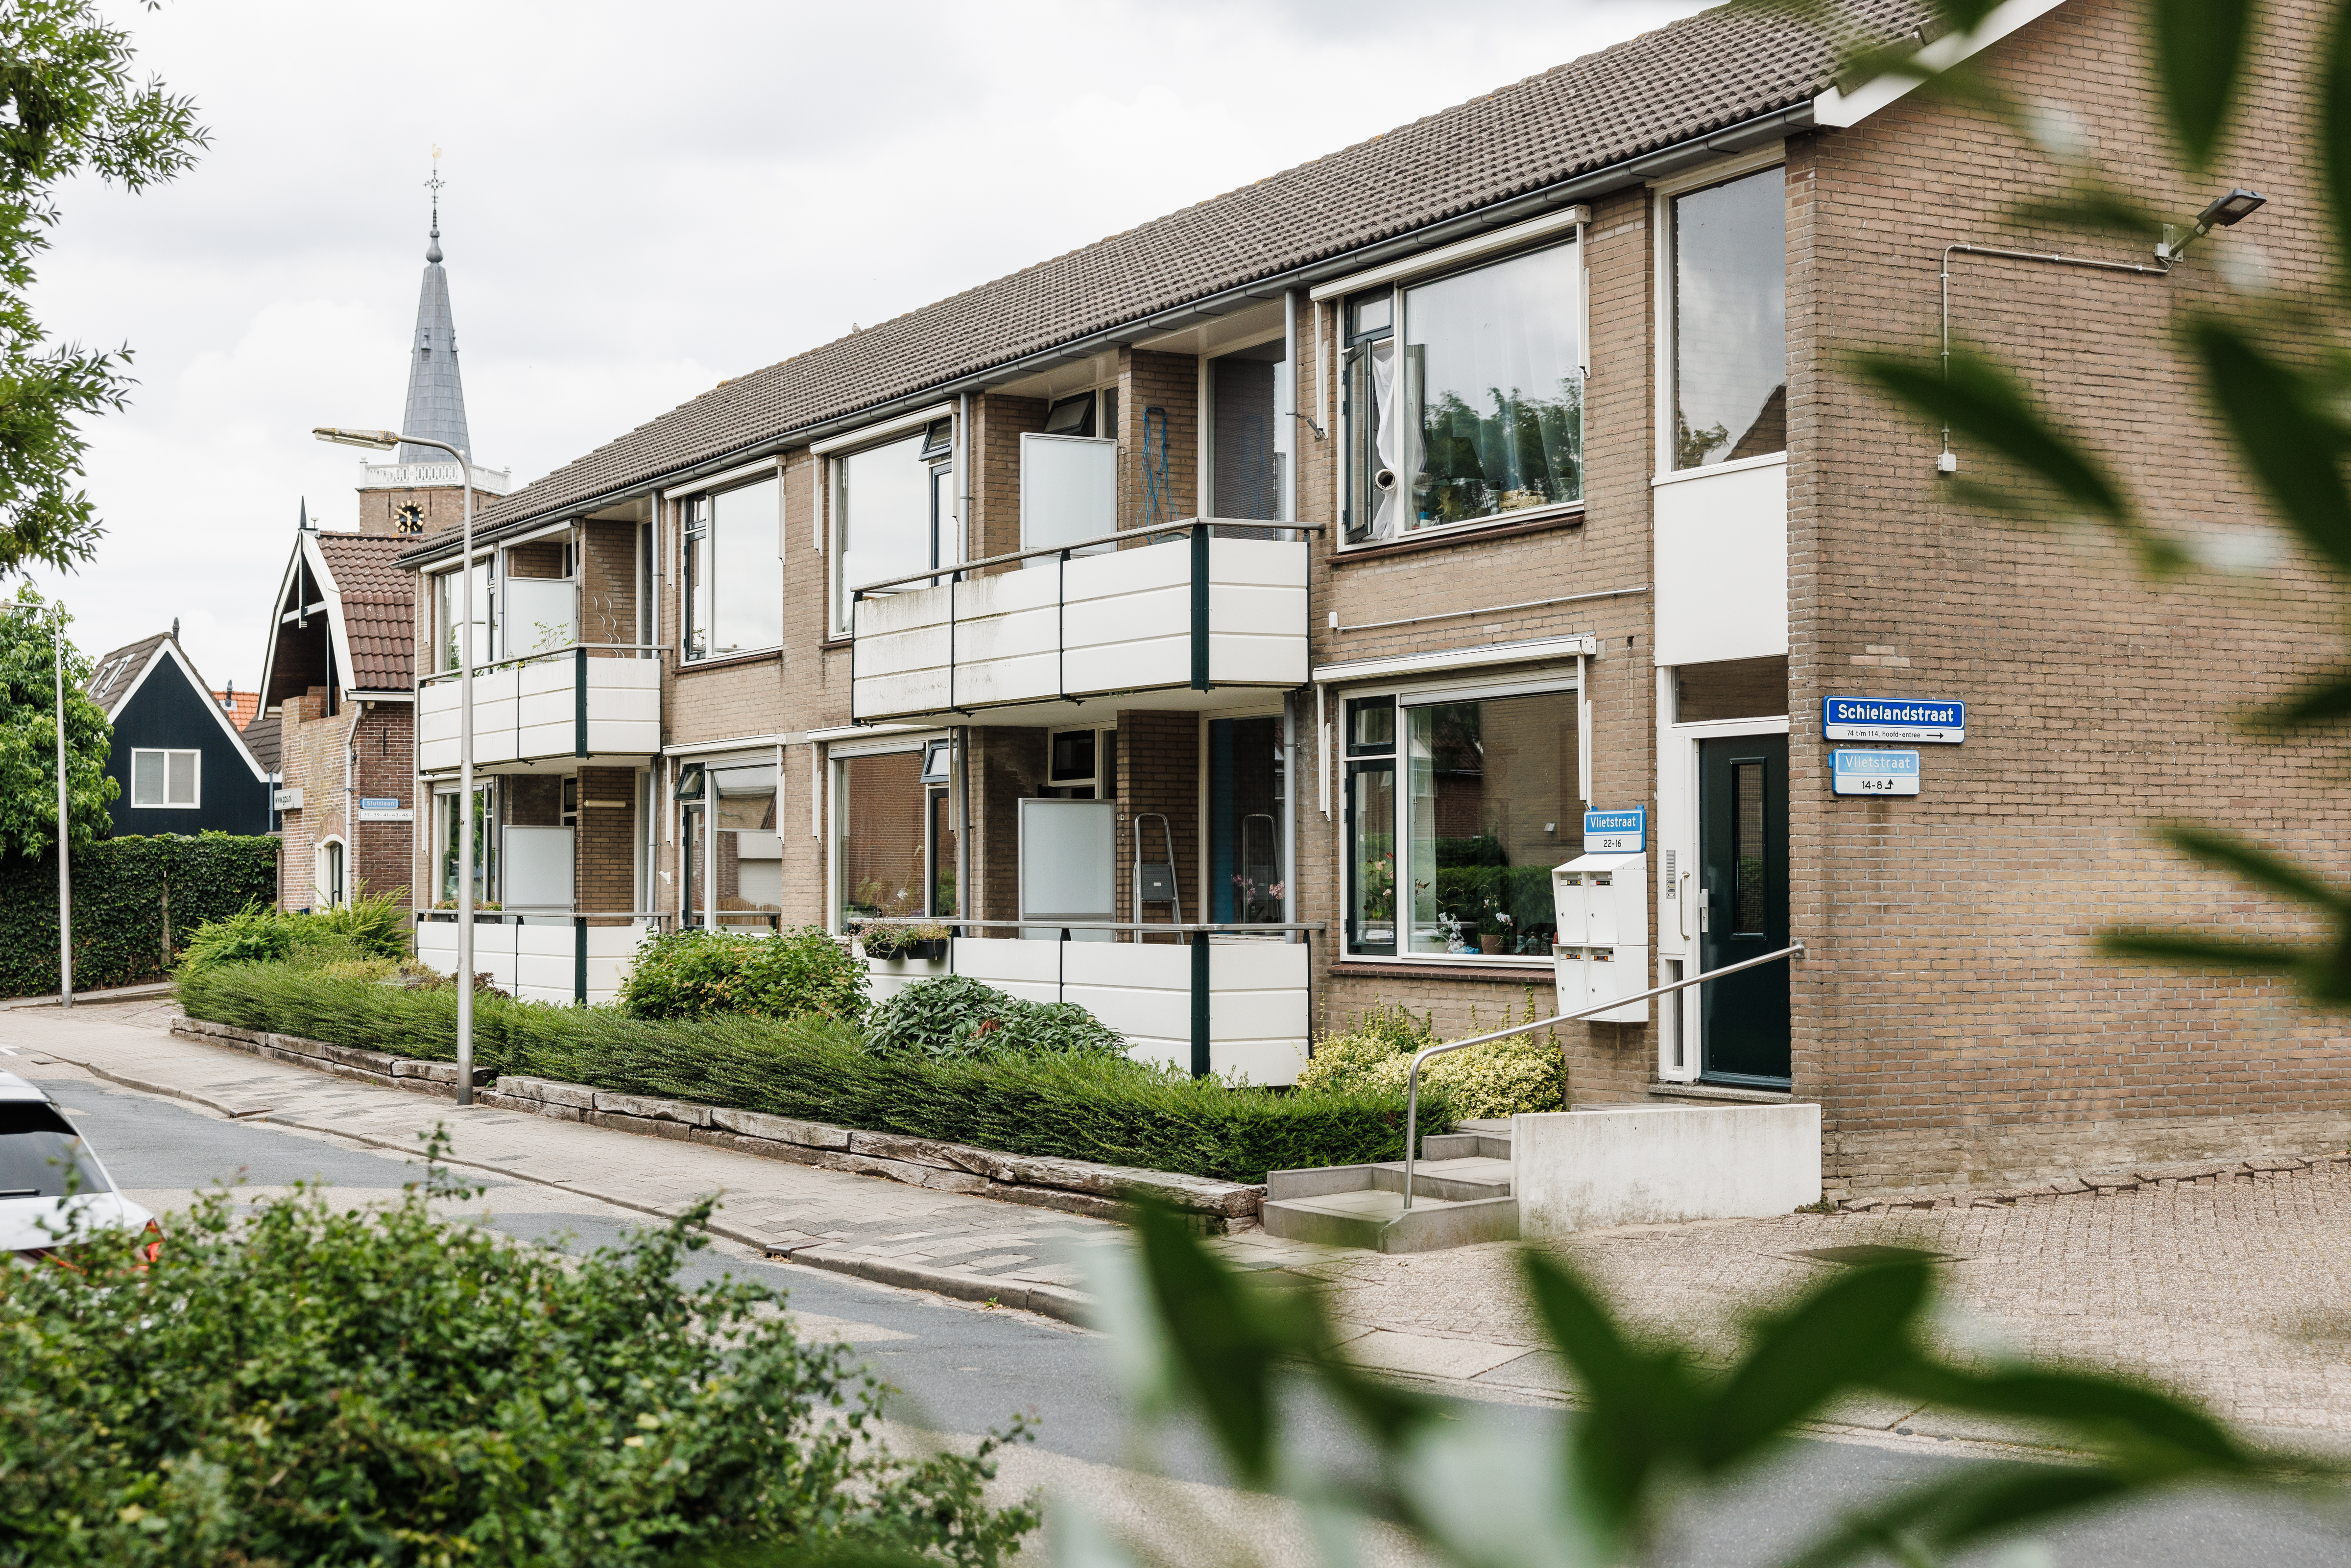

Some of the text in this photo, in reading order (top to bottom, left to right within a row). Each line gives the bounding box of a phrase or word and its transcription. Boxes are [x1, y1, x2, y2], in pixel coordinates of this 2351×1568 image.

[1838, 704, 1953, 722] Schielandstraat
[1845, 756, 1910, 768] Vlietstraat
[1862, 781, 1882, 790] 14-8
[1590, 816, 1636, 828] Vlietstraat
[1603, 839, 1622, 848] 22-16
